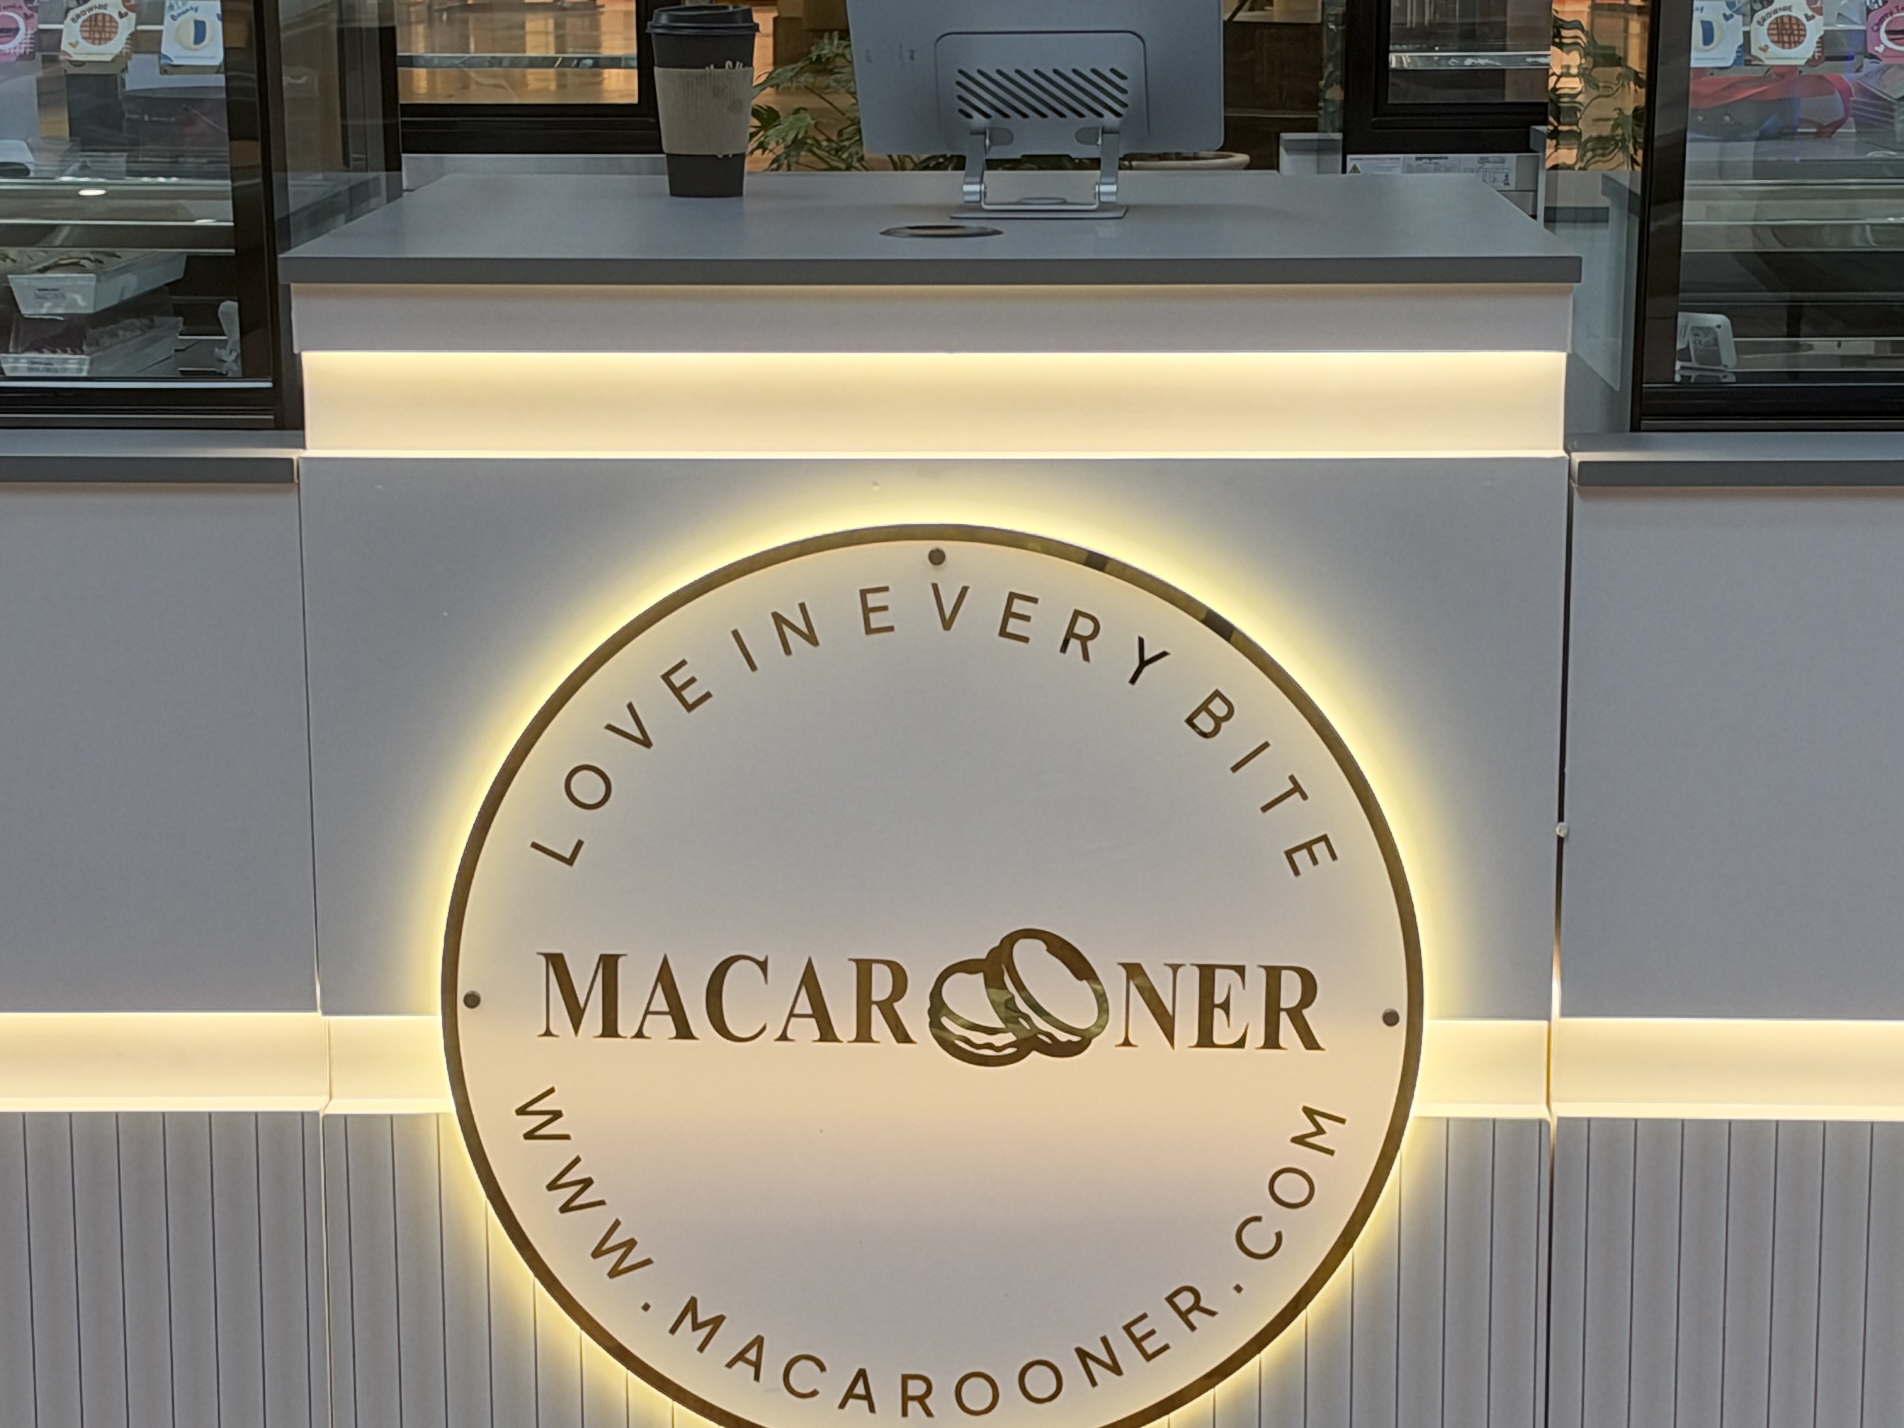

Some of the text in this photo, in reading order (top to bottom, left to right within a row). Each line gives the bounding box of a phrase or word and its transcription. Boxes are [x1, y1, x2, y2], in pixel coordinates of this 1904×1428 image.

[70, 2, 109, 24] BROWNIE
[1756, 4, 1794, 26] BROWNIE
[530, 582, 1339, 878] LOVE IN EVERY BITE
[513, 1086, 1348, 1420] WWW.MACAROONER.COM
